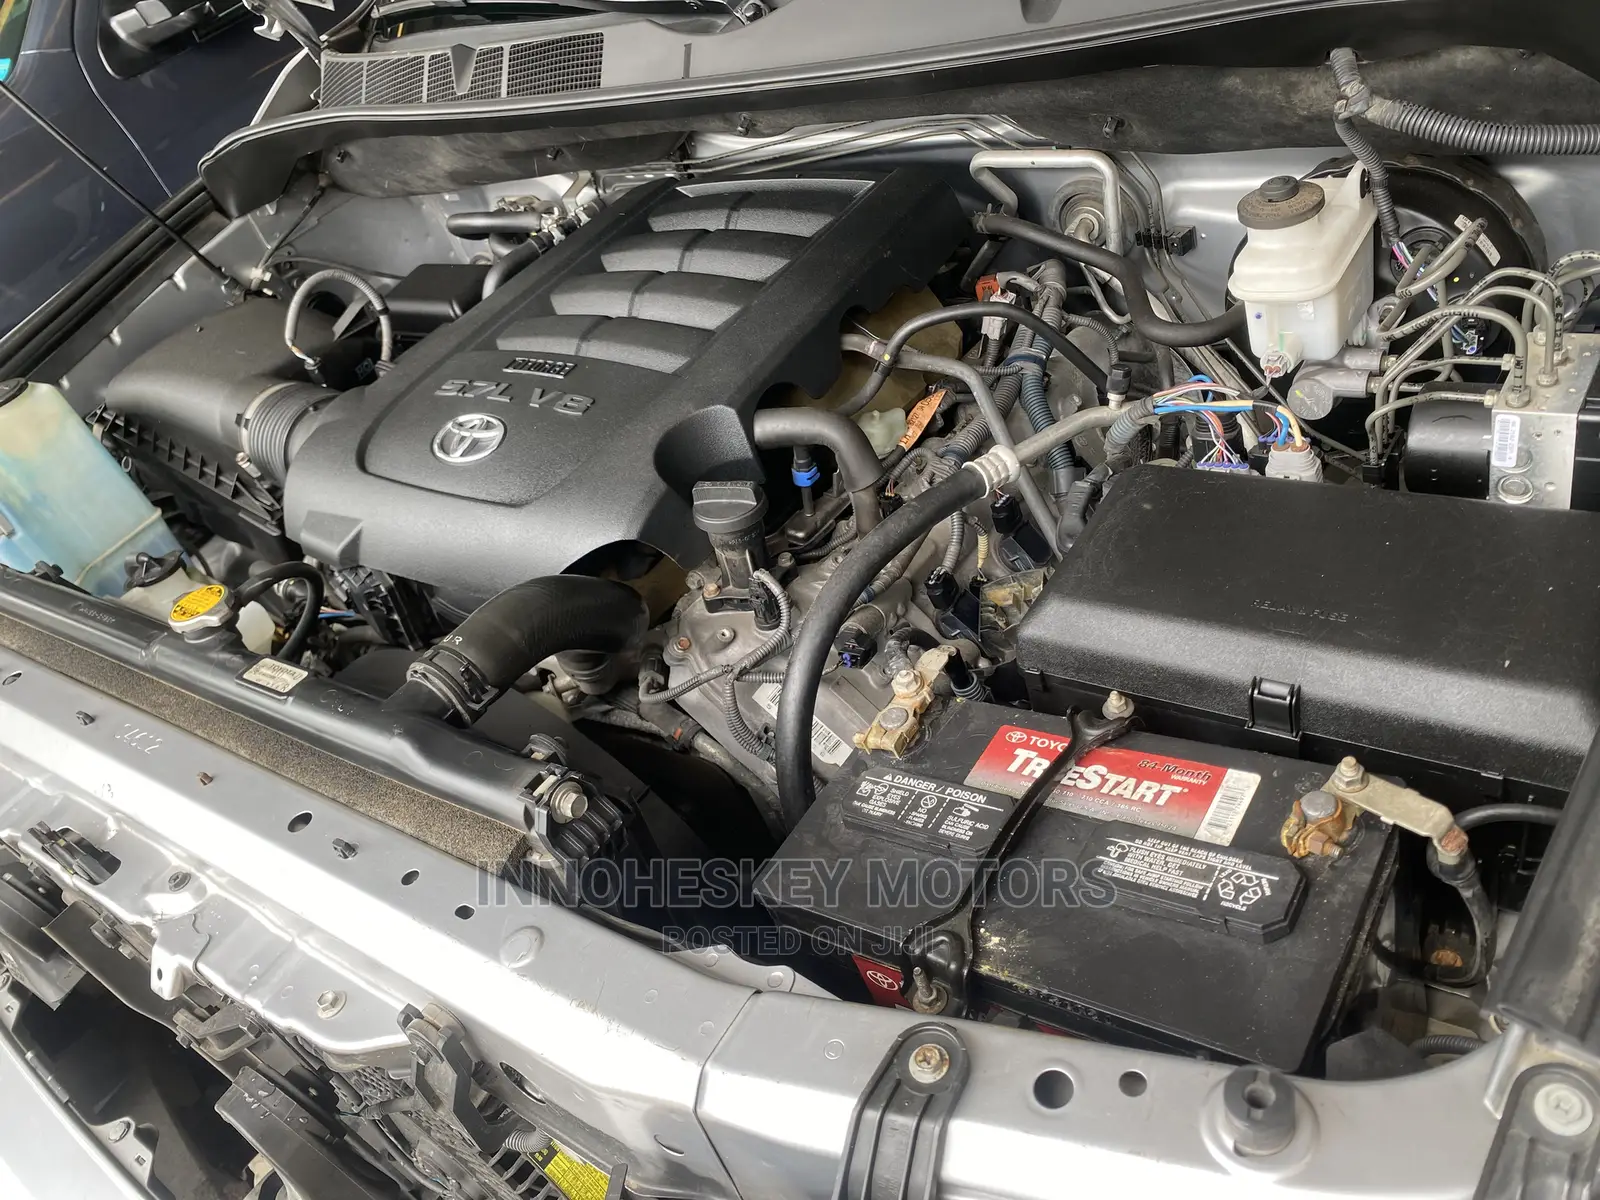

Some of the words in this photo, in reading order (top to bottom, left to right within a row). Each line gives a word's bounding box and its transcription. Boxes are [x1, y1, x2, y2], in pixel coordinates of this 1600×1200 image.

[529, 387, 595, 415] V8
[1030, 735, 1068, 752] TOYO
[1007, 748, 1184, 806] TRESTART
[1138, 759, 1212, 781] 84-Month
[1170, 774, 1208, 785] WARRANTY
[889, 788, 910, 796] SHIELD
[893, 775, 937, 791] DANGER
[935, 785, 944, 793] /
[944, 787, 987, 803] POISON
[867, 799, 887, 807] GASES
[871, 794, 901, 805] EXPLOSIVE
[945, 815, 975, 826] SULFURIC
[975, 822, 989, 830] ACID
[1126, 852, 1143, 860] WITH
[1166, 861, 1180, 869] GET
[1128, 846, 1150, 856] FLUSH
[1149, 851, 1165, 859] EYES
[1165, 855, 1207, 869] IMMEDIATELY
[1123, 857, 1150, 867] MEDICAL
[1150, 863, 1168, 872] HELP
[1167, 867, 1183, 876] FAST
